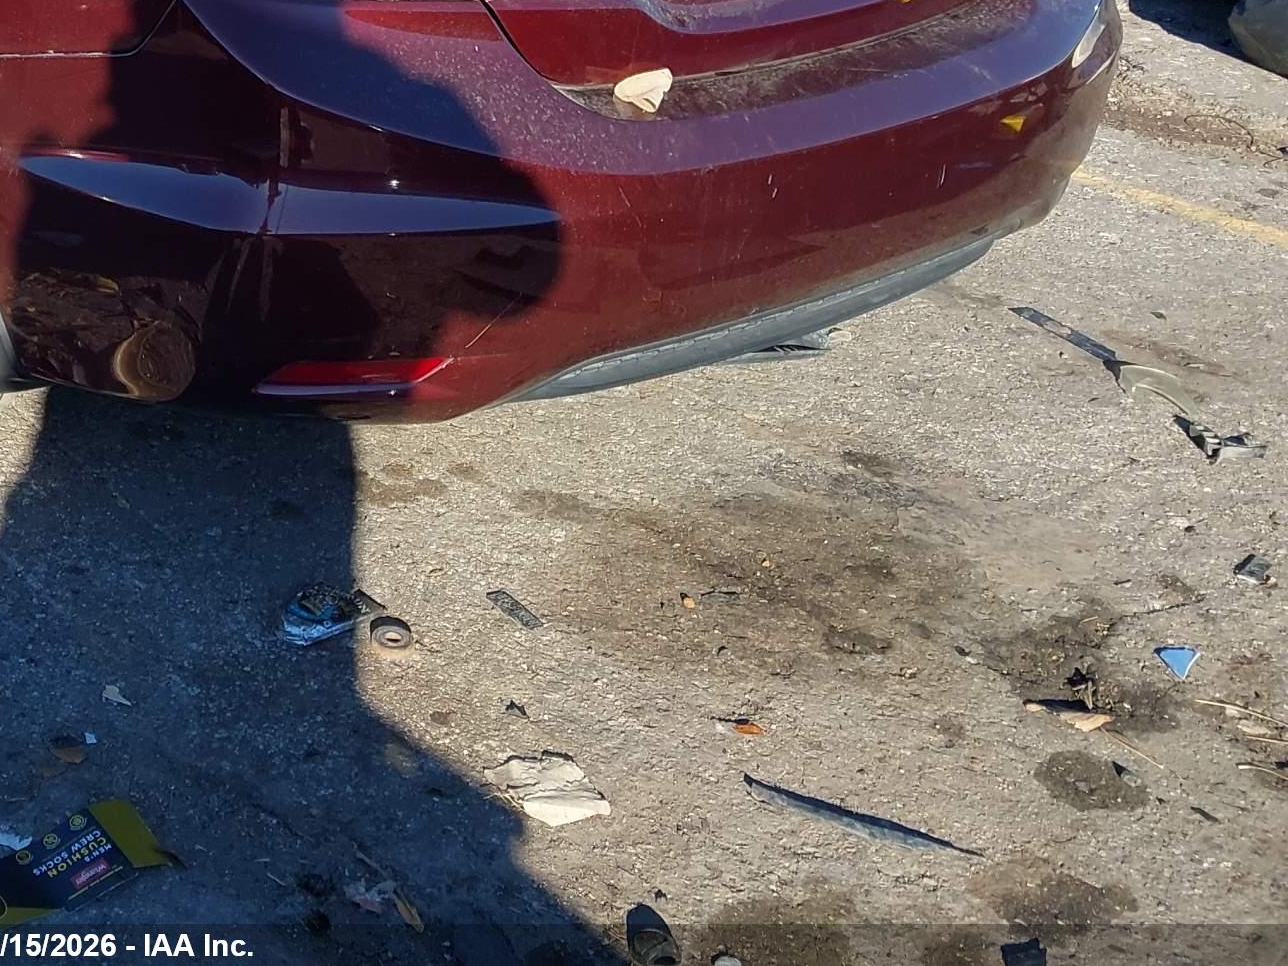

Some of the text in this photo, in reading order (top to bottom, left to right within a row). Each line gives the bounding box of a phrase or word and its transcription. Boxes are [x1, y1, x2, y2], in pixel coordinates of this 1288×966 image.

[32, 830, 101, 876] CREW SOCKS
[47, 837, 106, 878] CUSHION
[83, 843, 112, 863] MEN'S
